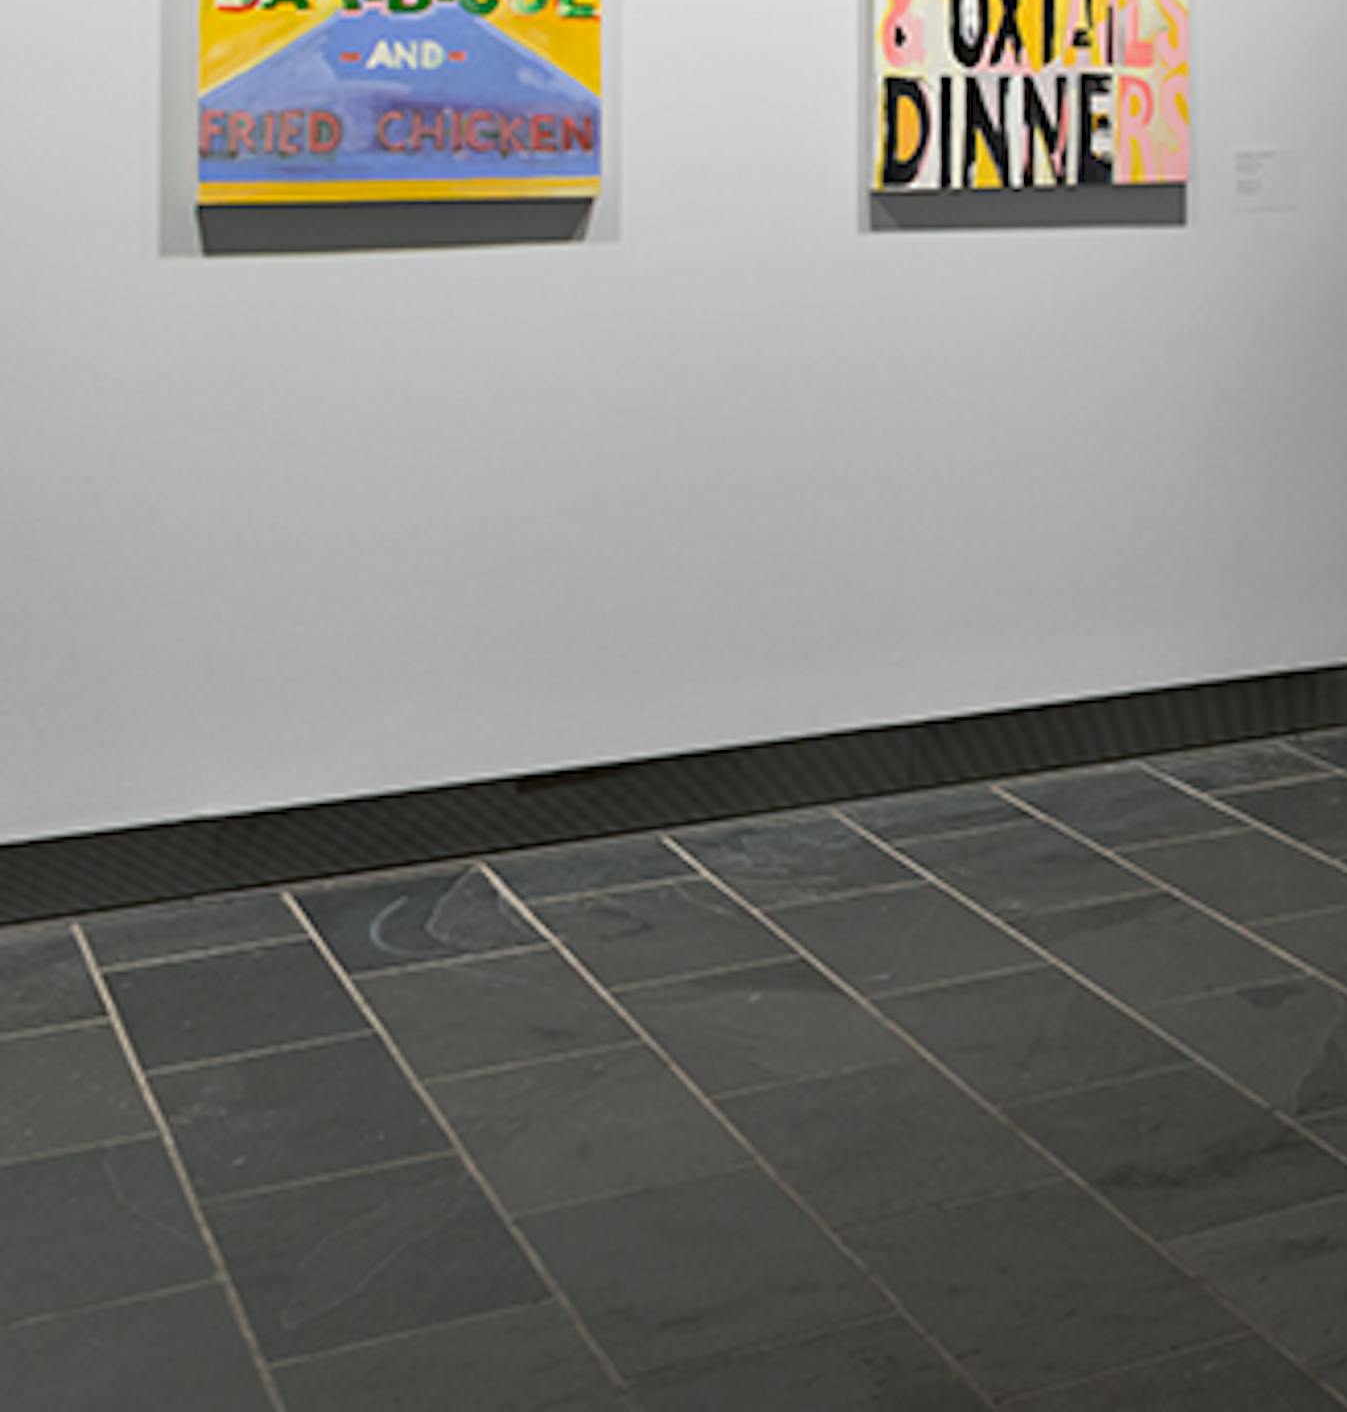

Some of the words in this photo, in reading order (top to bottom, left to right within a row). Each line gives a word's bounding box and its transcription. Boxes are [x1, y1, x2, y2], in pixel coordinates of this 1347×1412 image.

[199, 109, 343, 157] FRIED
[375, 109, 594, 156] CHICKEN
[883, 72, 1190, 188] DINNERS
